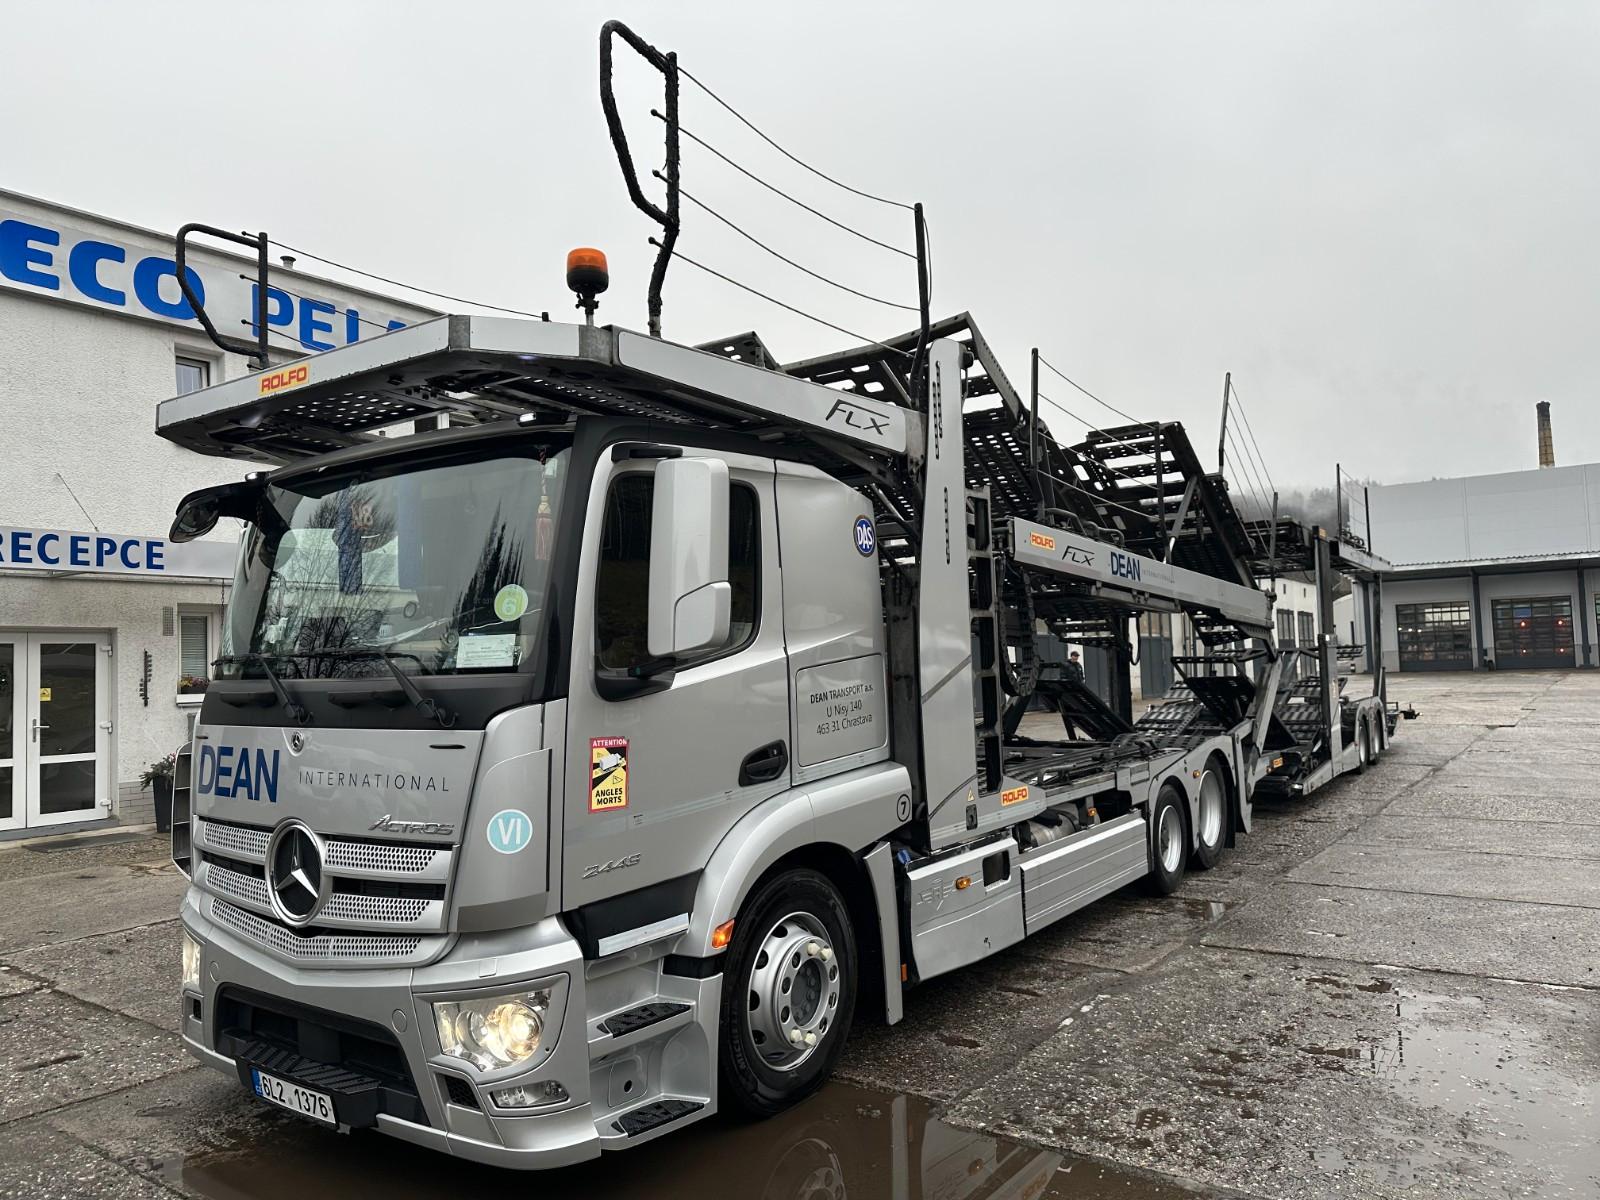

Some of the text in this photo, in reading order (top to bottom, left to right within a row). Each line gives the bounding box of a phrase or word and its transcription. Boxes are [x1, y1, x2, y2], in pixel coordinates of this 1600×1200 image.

[0, 219, 406, 352] ECO PEL
[261, 366, 307, 393] ROLFO
[825, 398, 890, 436] FLX
[856, 523, 873, 549] DAS
[1031, 534, 1054, 549] ROLFO
[0, 531, 165, 570] ECEPCE
[1062, 545, 1095, 567] FLX
[1110, 551, 1141, 582] DEAN
[810, 691, 828, 704] DEAN
[829, 683, 864, 700] TRANSPORT
[826, 699, 863, 718] U Nisy 140
[816, 714, 873, 735] 463 31 Chrastava
[592, 738, 627, 747] ATTENTION
[197, 744, 450, 803] DEAN INTERNATIONAL
[595, 787, 623, 798] ANGLES
[596, 795, 622, 806] MORTS
[1002, 788, 1028, 805] ROLFO
[900, 801, 908, 816] 7
[498, 818, 522, 845] VI
[261, 1075, 329, 1118] 6L2 1376
